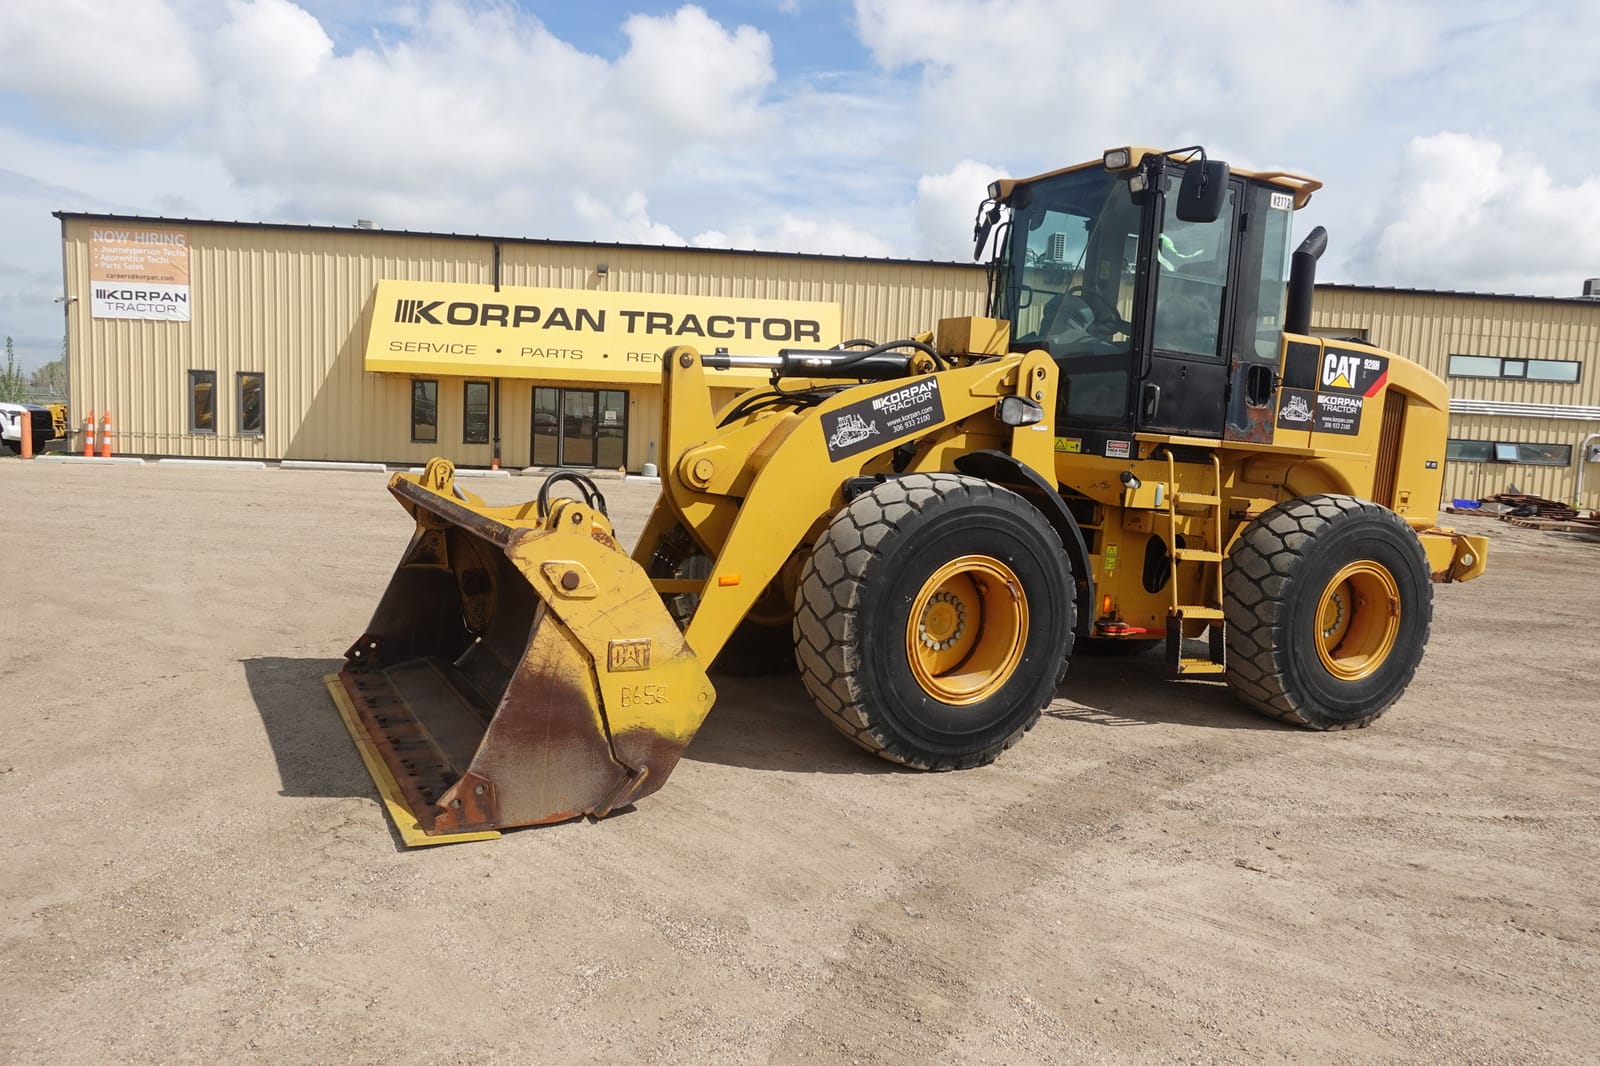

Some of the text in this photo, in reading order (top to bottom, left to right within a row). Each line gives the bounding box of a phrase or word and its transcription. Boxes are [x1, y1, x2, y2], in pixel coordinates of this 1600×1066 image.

[93, 230, 186, 247] NOW HIRING
[101, 246, 186, 257] Journeyperson Techs
[101, 254, 170, 264] Apprentice Techs
[106, 273, 175, 281] careers@korpan.com
[106, 289, 187, 303] KORPAN
[104, 302, 177, 313] TRACTOR
[412, 300, 821, 343] KORPAN TRACTOR
[389, 341, 478, 355] SERVICE
[520, 347, 584, 360] PARTS
[1322, 353, 1361, 389] CAT
[880, 379, 938, 408] KORPAN
[1322, 395, 1363, 408] KORPAN
[881, 391, 933, 415] TRACTOR
[1322, 404, 1358, 414] TRACTOR
[886, 406, 934, 426] www.korpan.com
[892, 414, 931, 433] 306 933 2100
[612, 644, 648, 668] CAT
